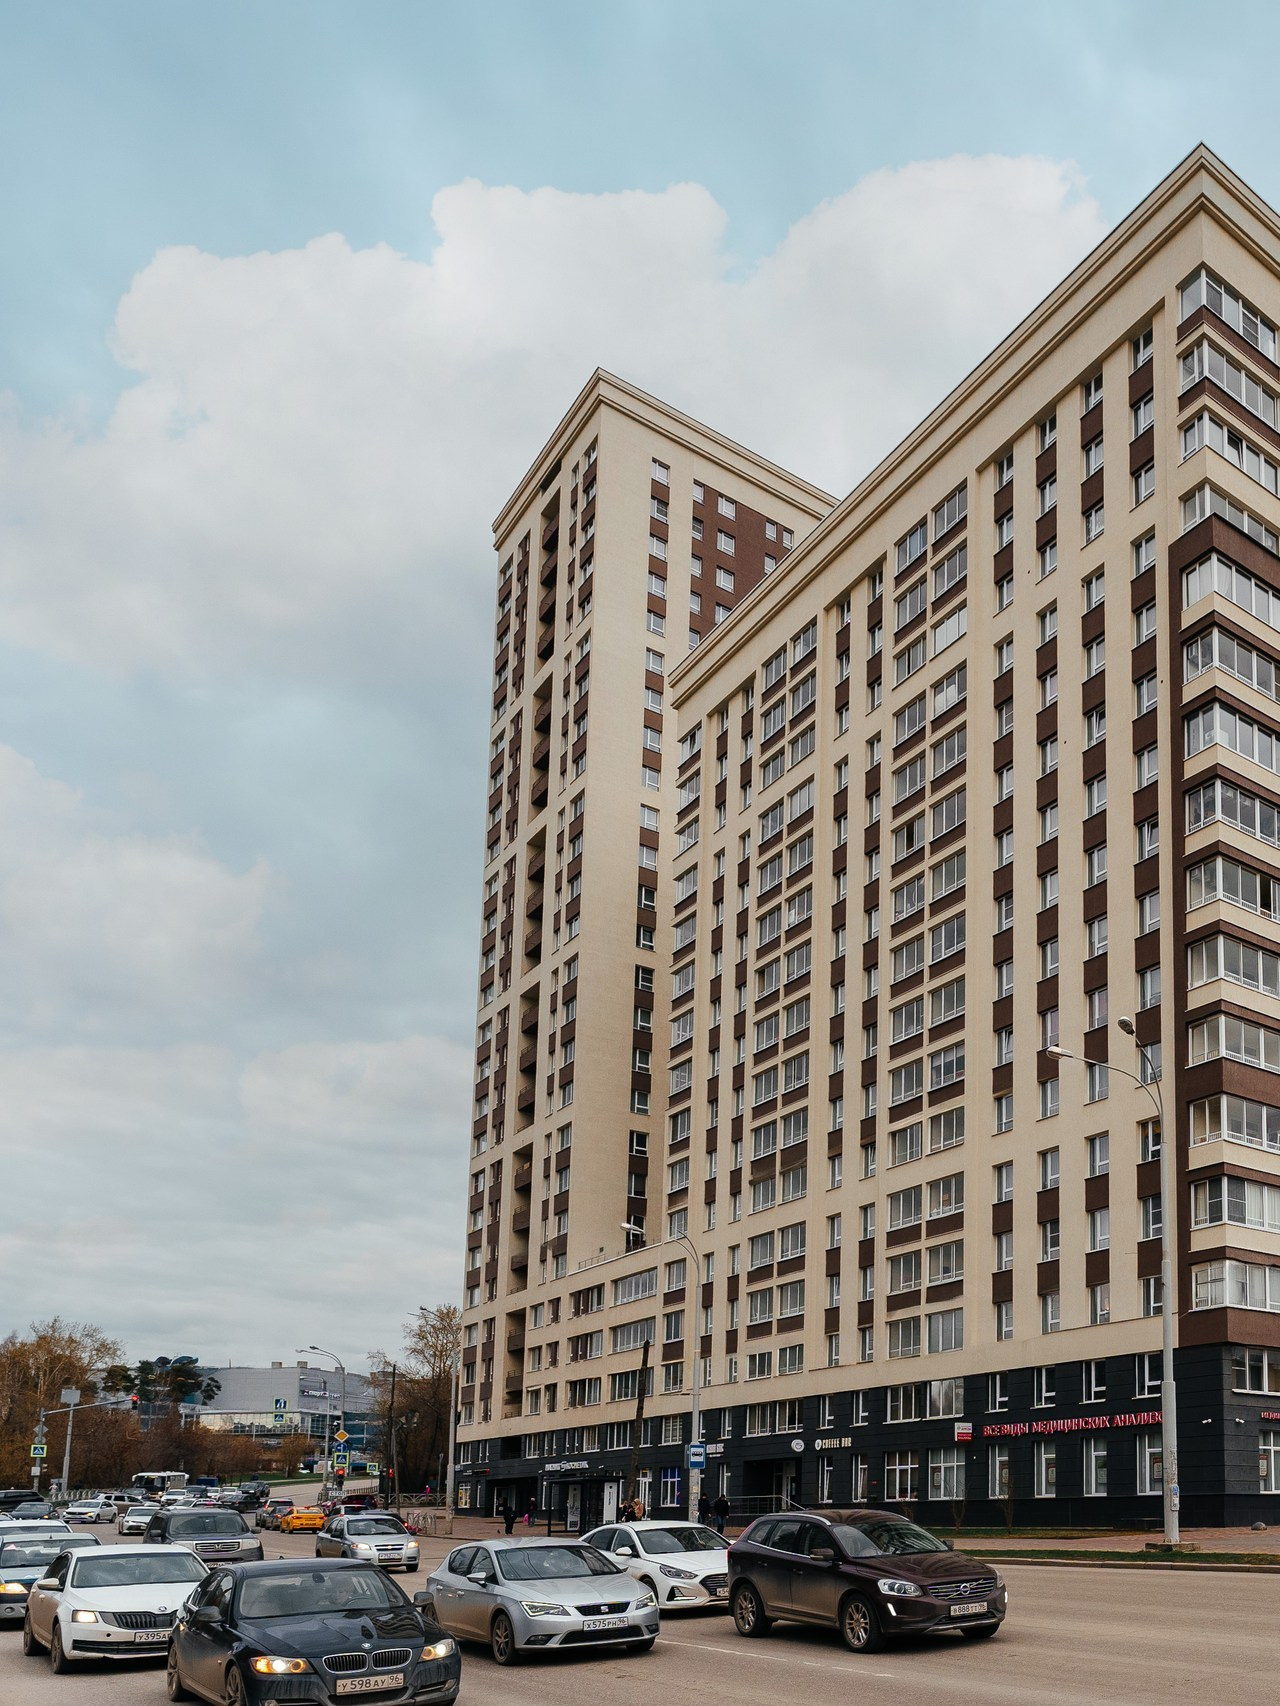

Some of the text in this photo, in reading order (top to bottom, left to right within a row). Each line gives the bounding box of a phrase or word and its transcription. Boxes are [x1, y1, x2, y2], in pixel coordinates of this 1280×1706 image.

[982, 1424, 1000, 1437] ВСЕ
[1001, 1422, 1029, 1437] ВИДЫ
[1031, 1415, 1110, 1434] МЕДИЦИНСКИХ
[1112, 1411, 1164, 1428] АНАЛИЗО
